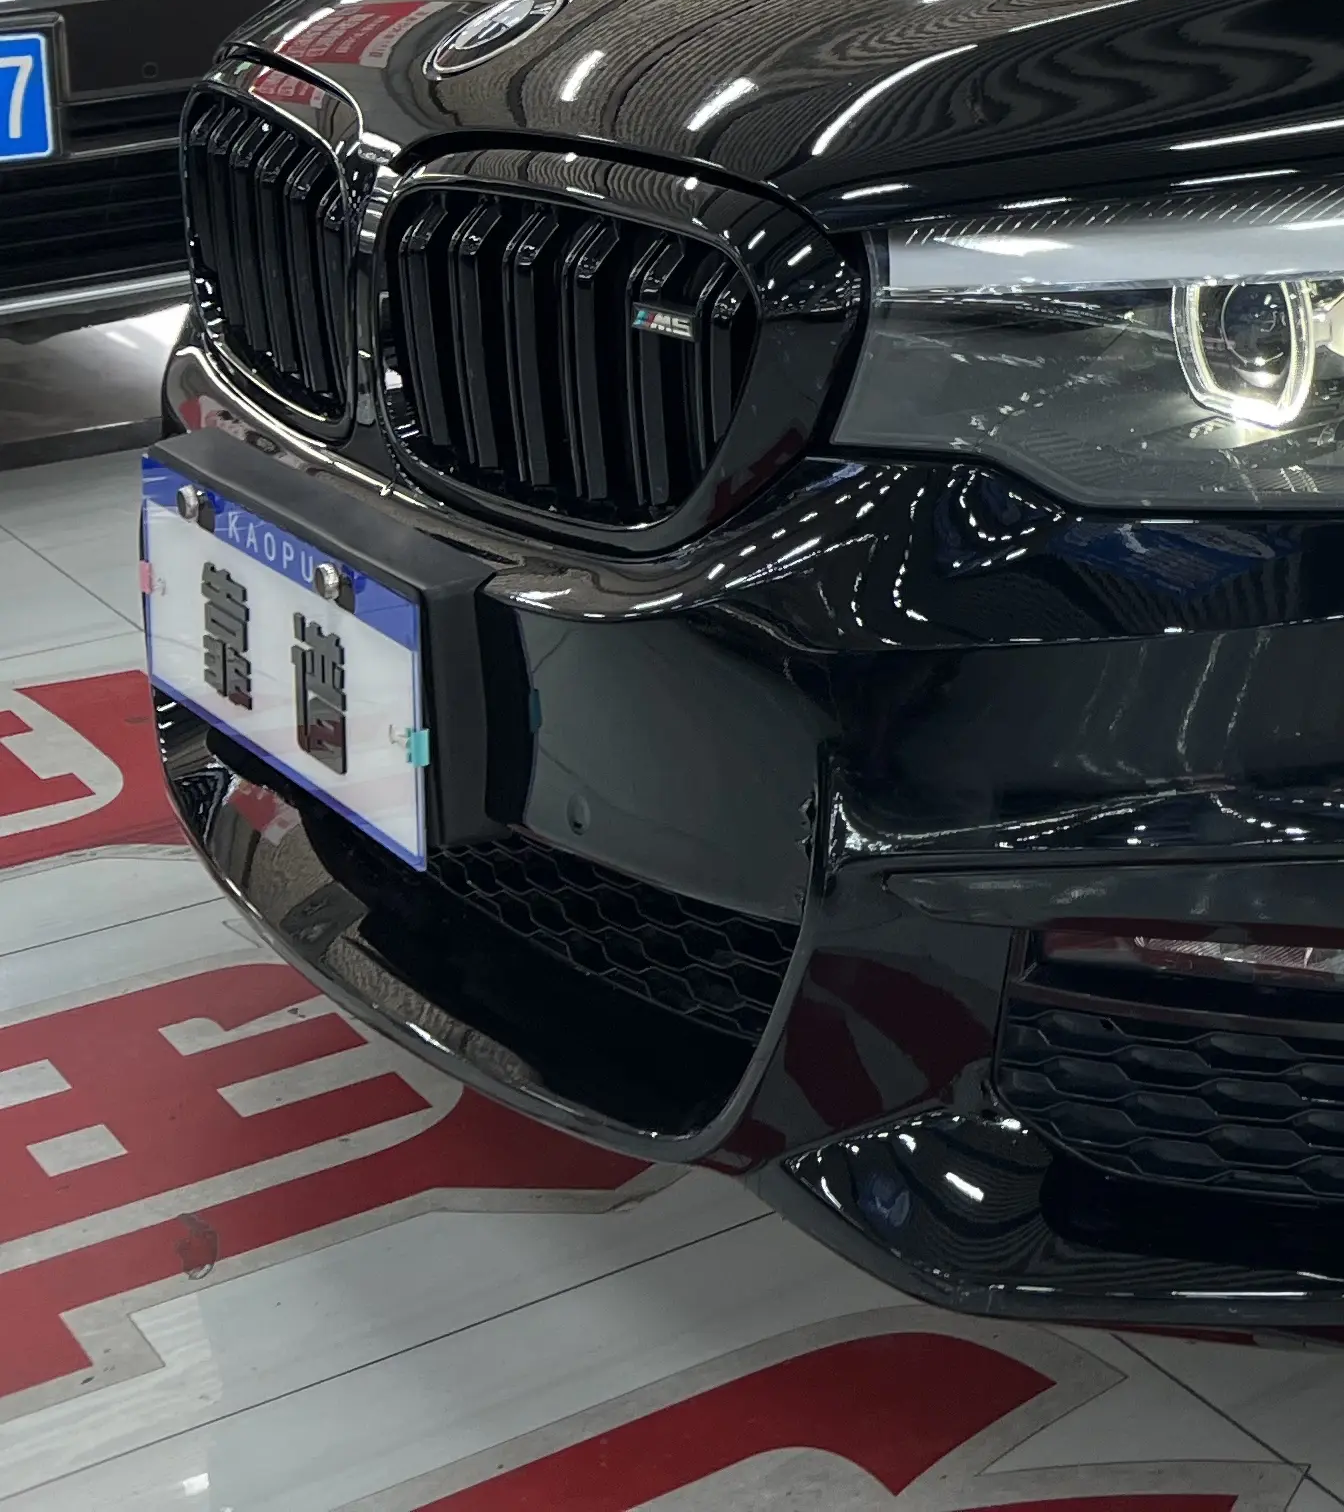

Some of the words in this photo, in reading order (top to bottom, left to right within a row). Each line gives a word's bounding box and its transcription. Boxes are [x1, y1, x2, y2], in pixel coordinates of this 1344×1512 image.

[0, 54, 34, 140] 7
[225, 510, 315, 584] KAOPU
[200, 561, 348, 776] 靠谱
